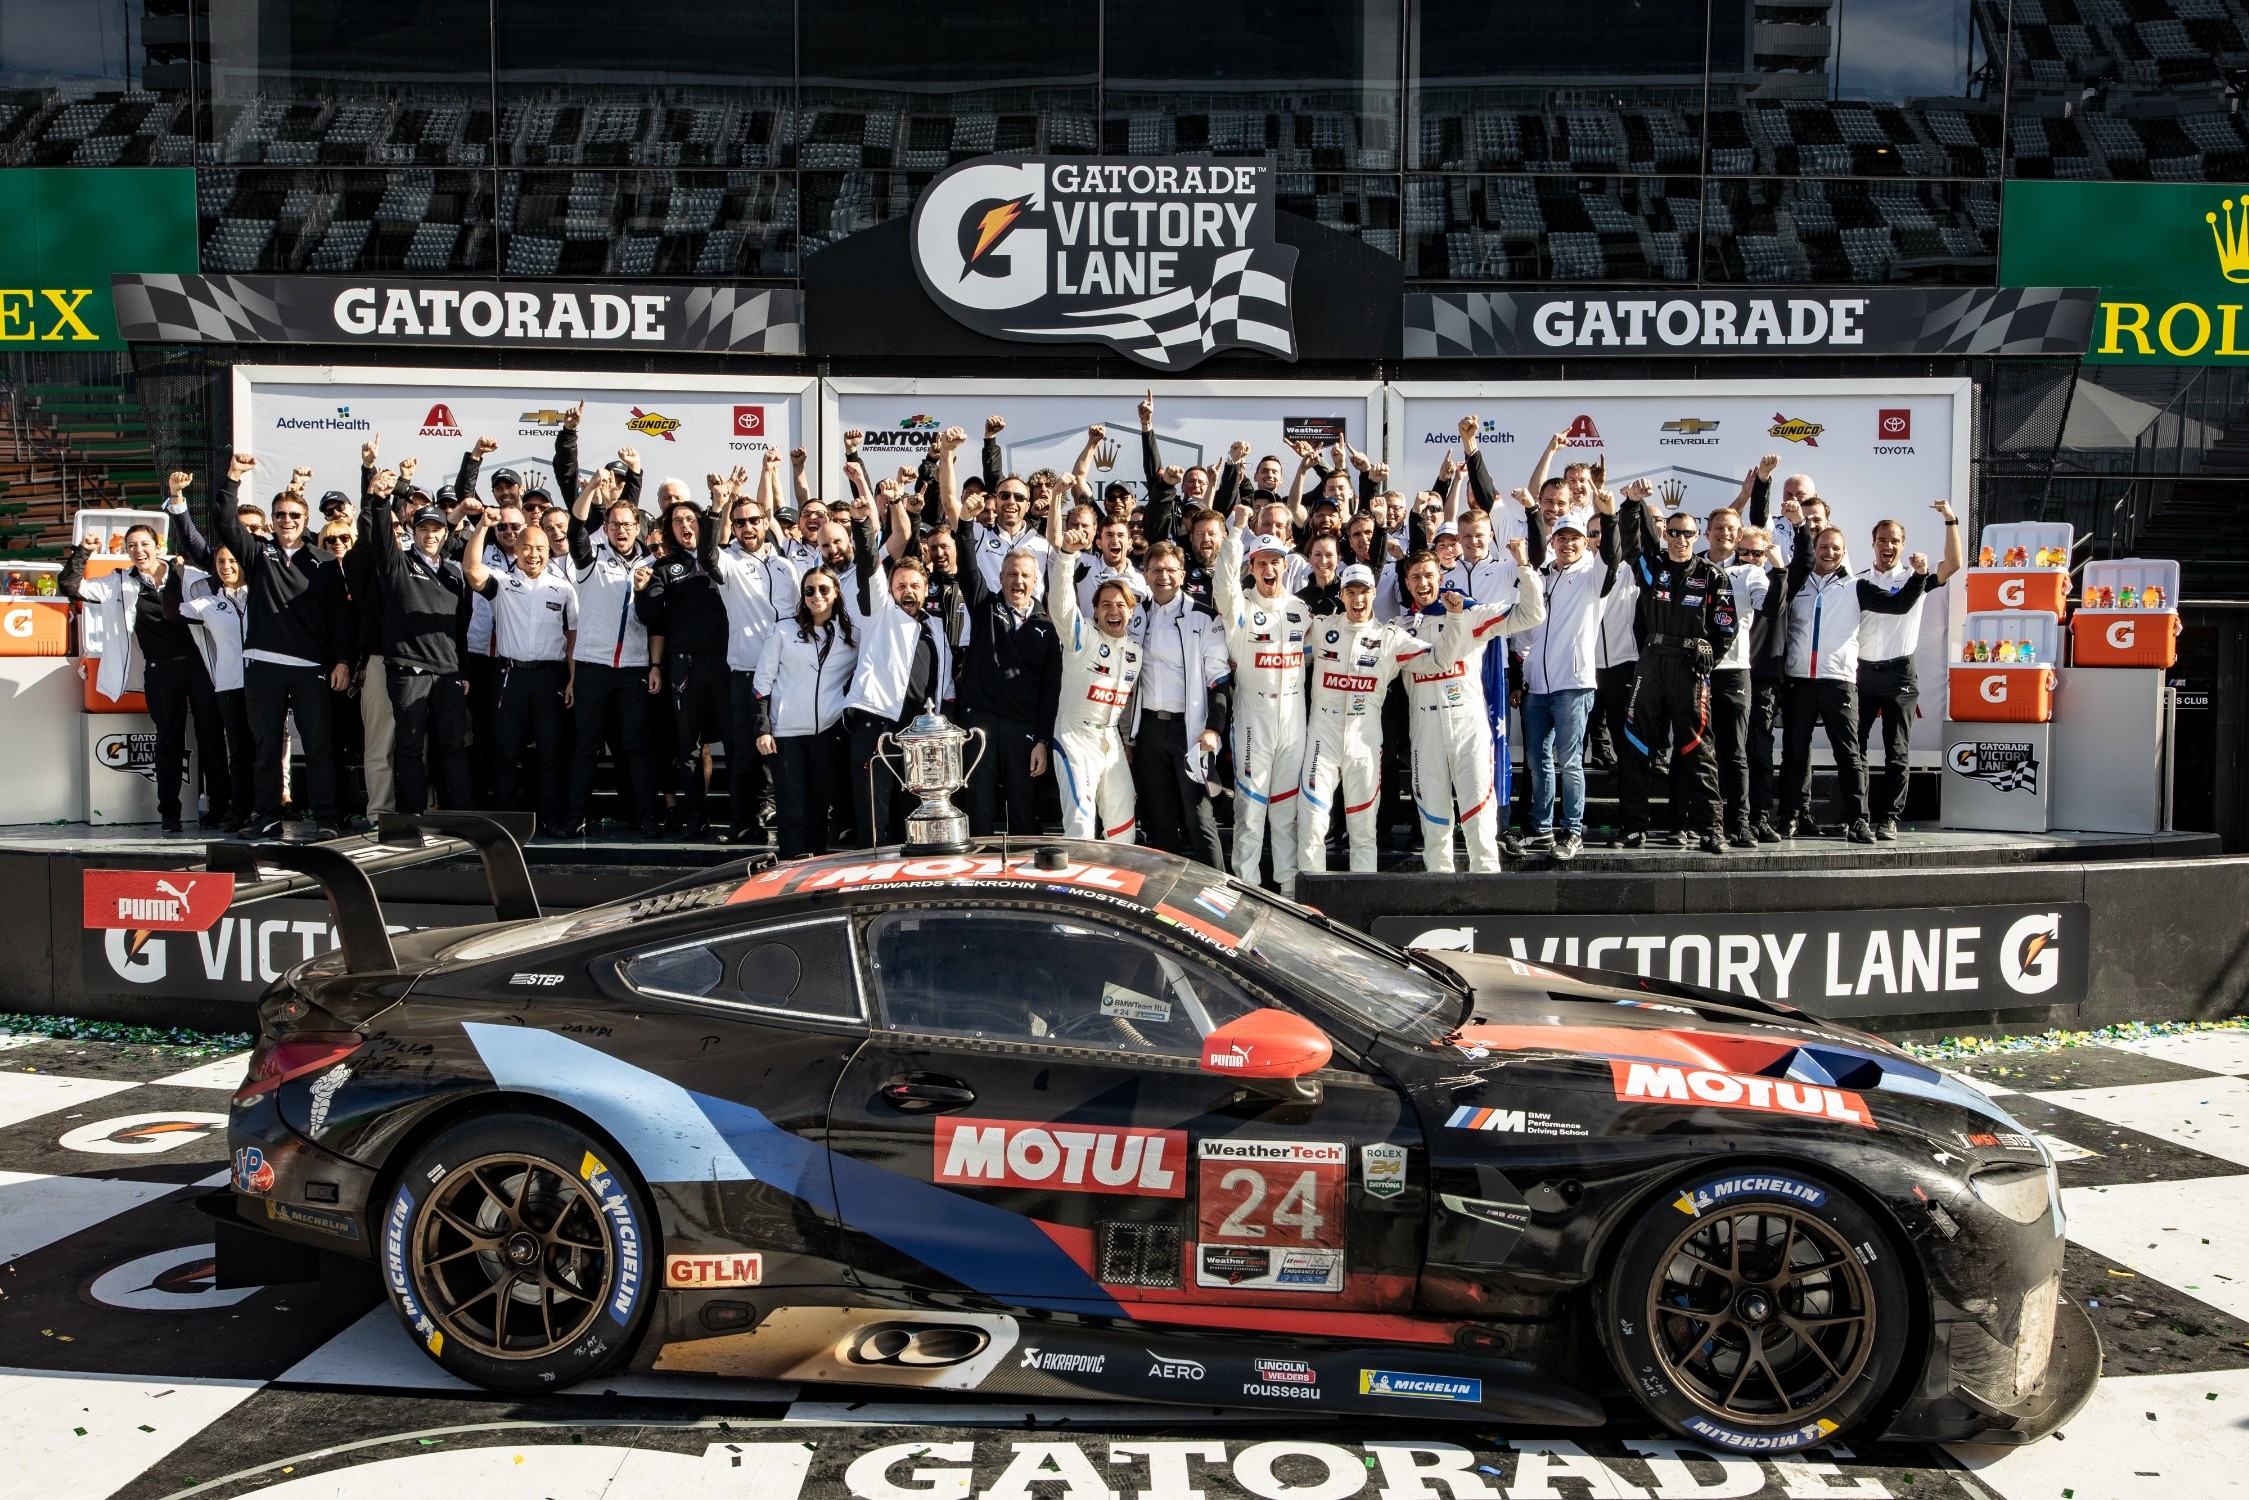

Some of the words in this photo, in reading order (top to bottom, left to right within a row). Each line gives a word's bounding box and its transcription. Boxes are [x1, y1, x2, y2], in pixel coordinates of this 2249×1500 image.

[1052, 165, 1256, 194] GATORADE
[1054, 202, 1257, 247] VICTORY
[1057, 251, 1179, 295] LANE
[334, 287, 667, 341] GATORADE
[1532, 299, 1866, 347] GATORADE
[276, 417, 370, 432] AdventHealth
[629, 419, 678, 432] SUNOCO
[1771, 424, 1822, 437] SUNOCO
[419, 428, 463, 437] AXALTA
[519, 428, 559, 437] CHEVRO
[862, 430, 940, 447] DAYTON
[1424, 431, 1514, 446] AdvenHealth
[729, 442, 769, 451] TOYOTA
[862, 445, 913, 453] INTERNATIONAL
[1659, 437, 1720, 446] CHEVROLET
[1873, 446, 1915, 456] TOYOTA
[1258, 653, 1302, 669] MOTUL
[1325, 674, 1373, 692] MOTUL
[2184, 697, 2209, 705] CLUB
[130, 743, 157, 752] VICT
[1979, 743, 2030, 752] GATORADE
[130, 753, 156, 763] LAN
[1311, 740, 1321, 773] Motorsport
[1979, 750, 2029, 762] VICTORY
[1979, 761, 2008, 771] LANE
[810, 859, 1130, 889] MOTUL
[118, 897, 180, 922] PUMA
[859, 879, 945, 892] EDWARDS
[973, 879, 1037, 889] KROHN
[1067, 886, 1153, 915] MOSTERT
[1174, 922, 1239, 958] FARFUS
[198, 917, 345, 983] VICT
[1825, 926, 1981, 997] LANE
[526, 973, 565, 986] STEP
[1119, 1008, 1129, 1017] 24
[1154, 1004, 1169, 1013] RLL
[1210, 1053, 1243, 1068] PUMA
[1625, 1063, 1861, 1123] MOTUL
[1527, 1111, 1551, 1120] BMW
[1527, 1119, 1581, 1129] Performance
[1527, 1127, 1558, 1137] Driving
[1558, 1128, 1589, 1137] School
[942, 1125, 1175, 1190] MOTUL
[1204, 1143, 1340, 1160] WeatherTech
[1366, 1149, 1402, 1159] ROLEX
[1368, 1160, 1401, 1175] 24
[250, 1173, 274, 1187] Racing
[1368, 1181, 1401, 1189] DAYTONA
[1713, 1178, 1821, 1203] MICHELIN
[1217, 1168, 1325, 1240] 24
[291, 1211, 349, 1232] MICHELIN
[389, 1197, 418, 1316] MICHELIN
[601, 1193, 638, 1315] MICHELIN
[1206, 1256, 1267, 1266] WeatherTech
[670, 1257, 759, 1283] GTLM
[1042, 1353, 1106, 1374] AKRAPOVIČ
[1257, 1360, 1306, 1373] LINCOLN
[1148, 1362, 1205, 1381] AERO
[1267, 1371, 1311, 1382] WELDERS
[1243, 1383, 1321, 1399] rousseau
[1393, 1378, 1471, 1395] MICHELIN
[1692, 1420, 1799, 1449] MICHELIN
[843, 1440, 1895, 1500] GATORADE
